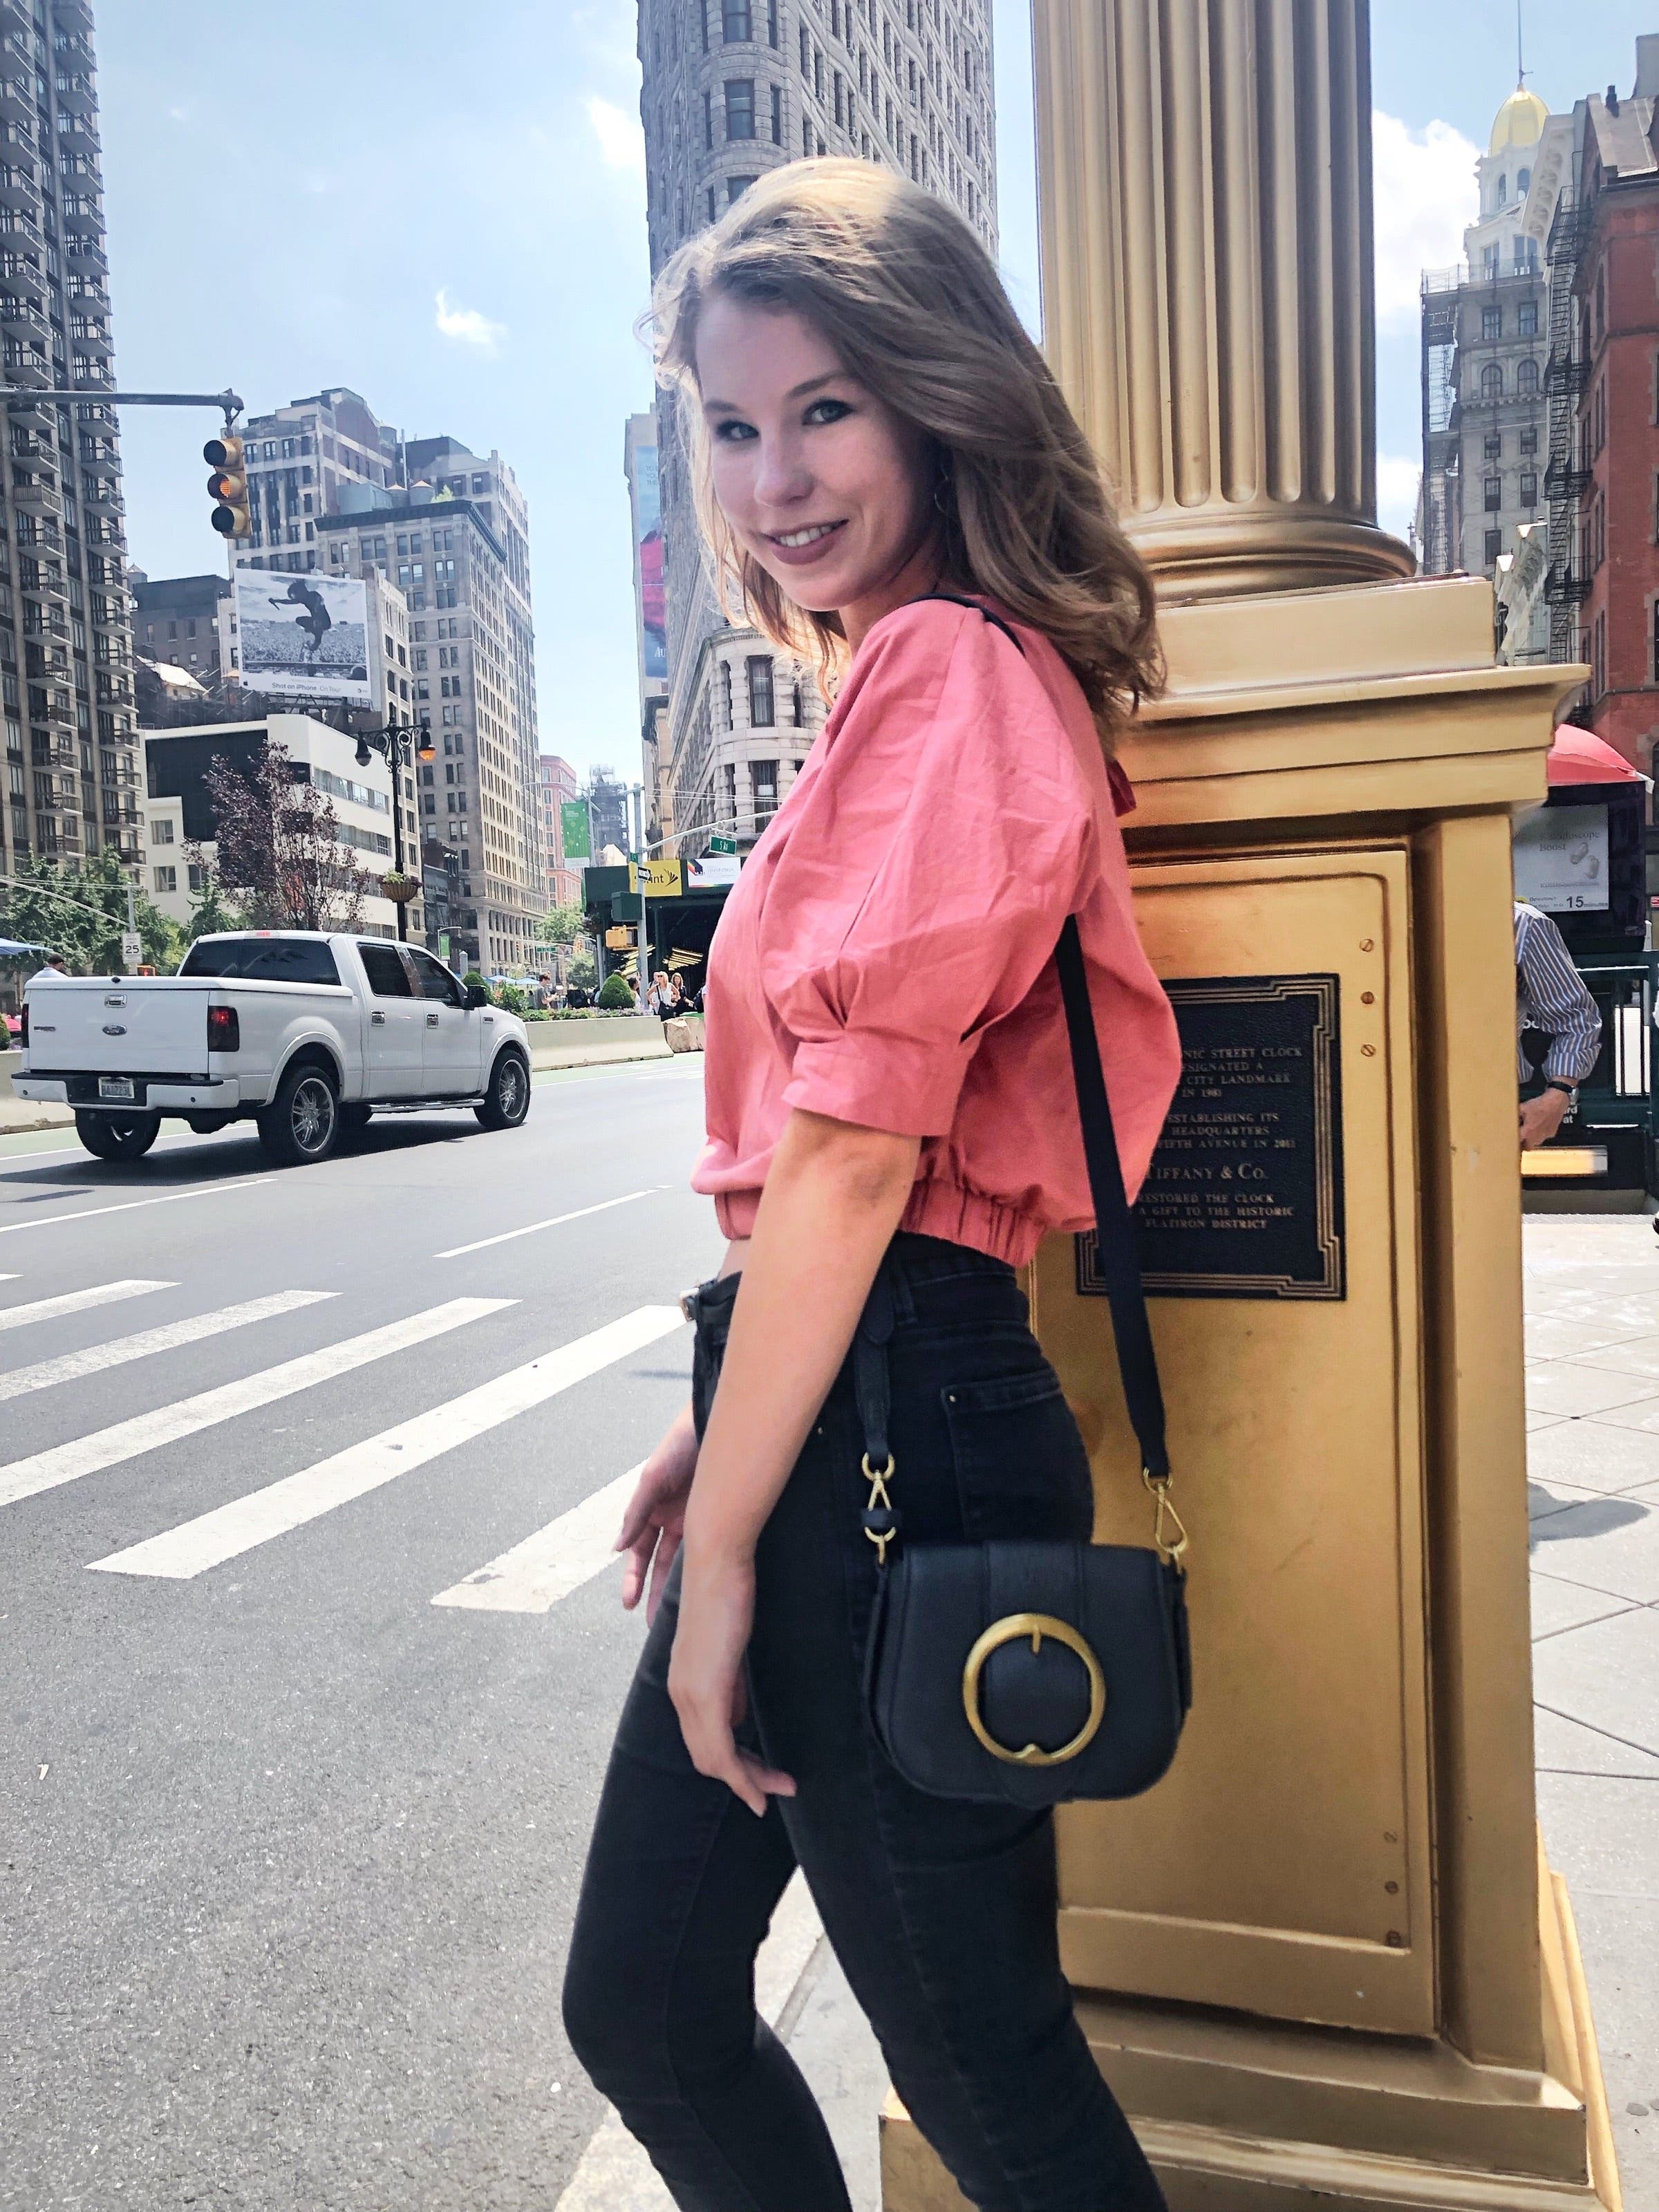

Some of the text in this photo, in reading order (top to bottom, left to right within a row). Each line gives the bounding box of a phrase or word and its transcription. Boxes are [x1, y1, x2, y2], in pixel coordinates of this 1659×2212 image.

[1566, 896, 1584, 908] 15
[125, 944, 140, 954] 25
[1183, 1047, 1302, 1059] NIC STREET CLOCK
[1182, 1061, 1264, 1072] ESIGNATED A
[1186, 1074, 1291, 1085] CITY LANDMARK
[1260, 1112, 1280, 1123] ITS
[1171, 1126, 1271, 1137] HEADQUARTERS
[1198, 1138, 1248, 1149] AVENUE
[1220, 1165, 1233, 1180] &
[1206, 1193, 1229, 1203] THE
[1235, 1193, 1275, 1203] CLOCK
[1152, 1206, 1179, 1217] GIFT
[1185, 1206, 1201, 1217] TO
[1208, 1206, 1230, 1217] THE
[1237, 1206, 1295, 1217] HISTORIC
[1145, 1218, 1268, 1229] FLATIRON DISTRICT
